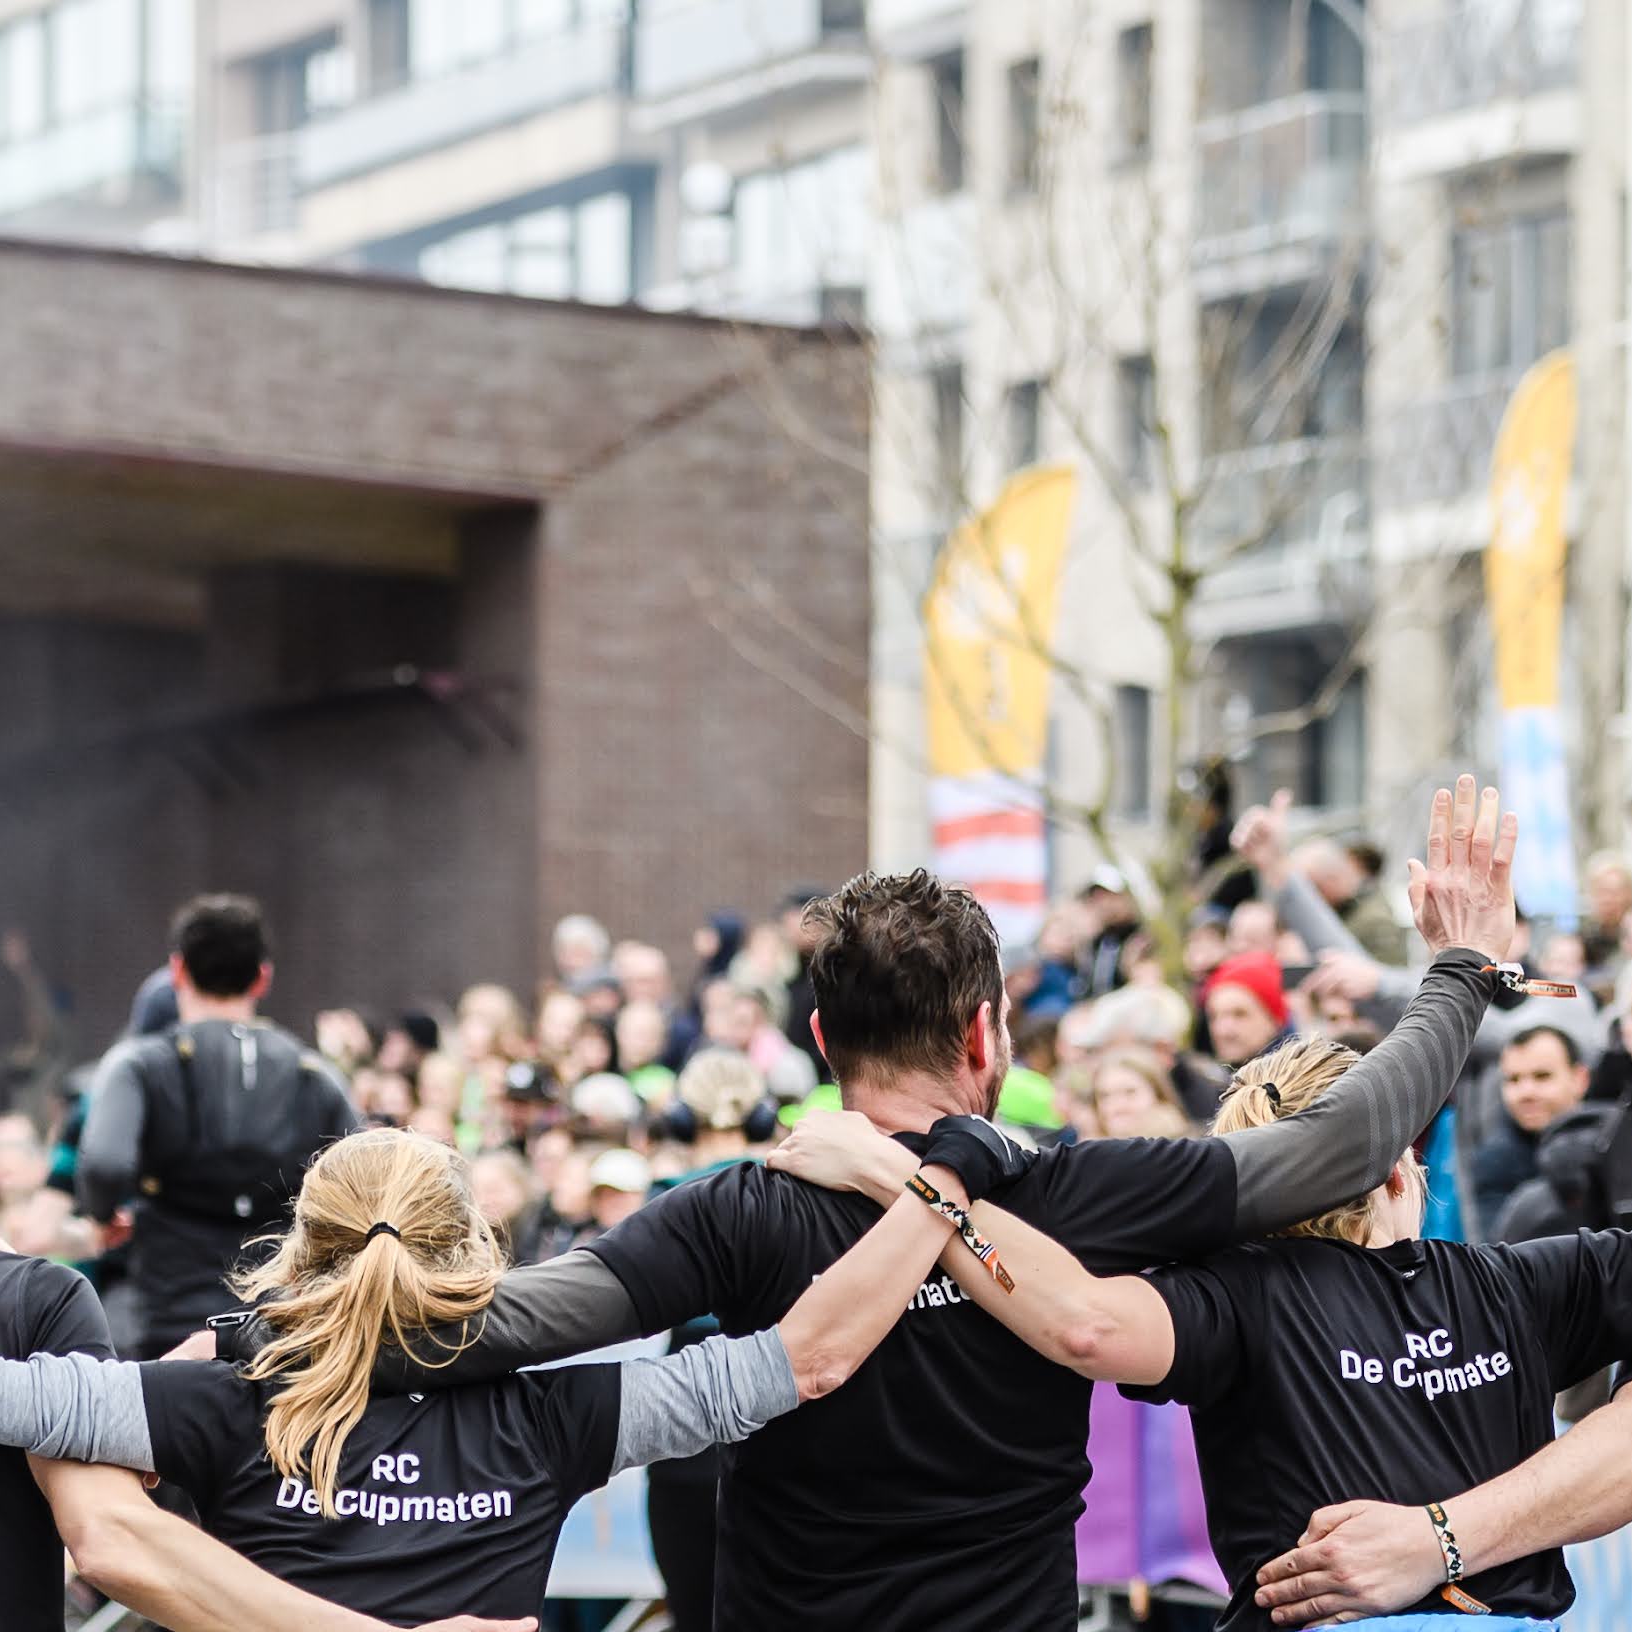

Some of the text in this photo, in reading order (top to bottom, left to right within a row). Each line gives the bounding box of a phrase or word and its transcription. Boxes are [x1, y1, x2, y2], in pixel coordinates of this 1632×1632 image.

[1405, 1328, 1453, 1359] RC
[1340, 1349, 1384, 1384] De
[371, 1453, 420, 1484] RC
[275, 1477, 512, 1526] De Cupmaten
